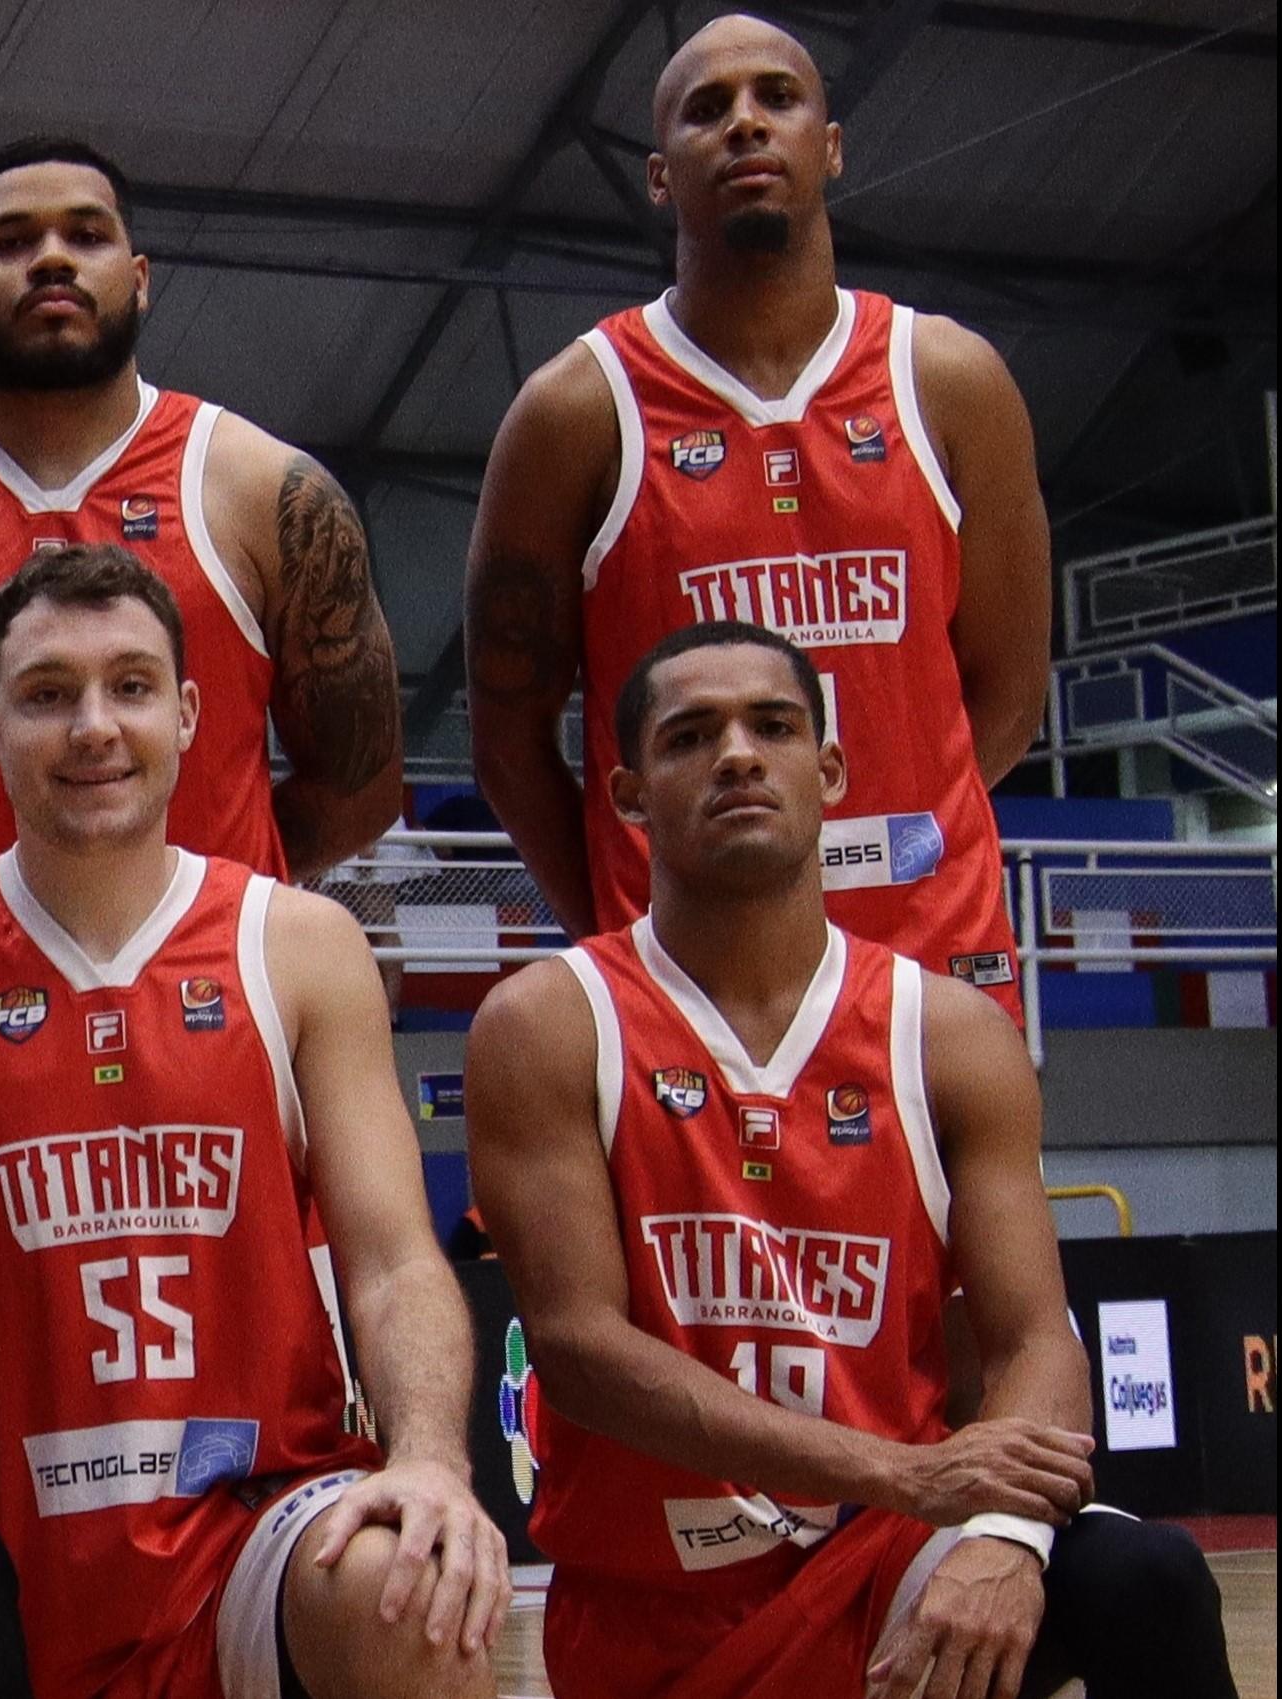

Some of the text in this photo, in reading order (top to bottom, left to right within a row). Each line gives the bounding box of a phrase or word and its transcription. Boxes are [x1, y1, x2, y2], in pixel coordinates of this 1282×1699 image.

[674, 445, 725, 467] FCB
[688, 556, 901, 625] TITANES
[788, 627, 876, 642] ANQUILLA
[656, 1084, 707, 1109] FCB
[52, 1214, 201, 1240] BARRANQUILLA
[648, 1220, 883, 1321] TITANES
[79, 1254, 196, 1385] 55
[37, 1452, 177, 1488] TECNOGLAS
